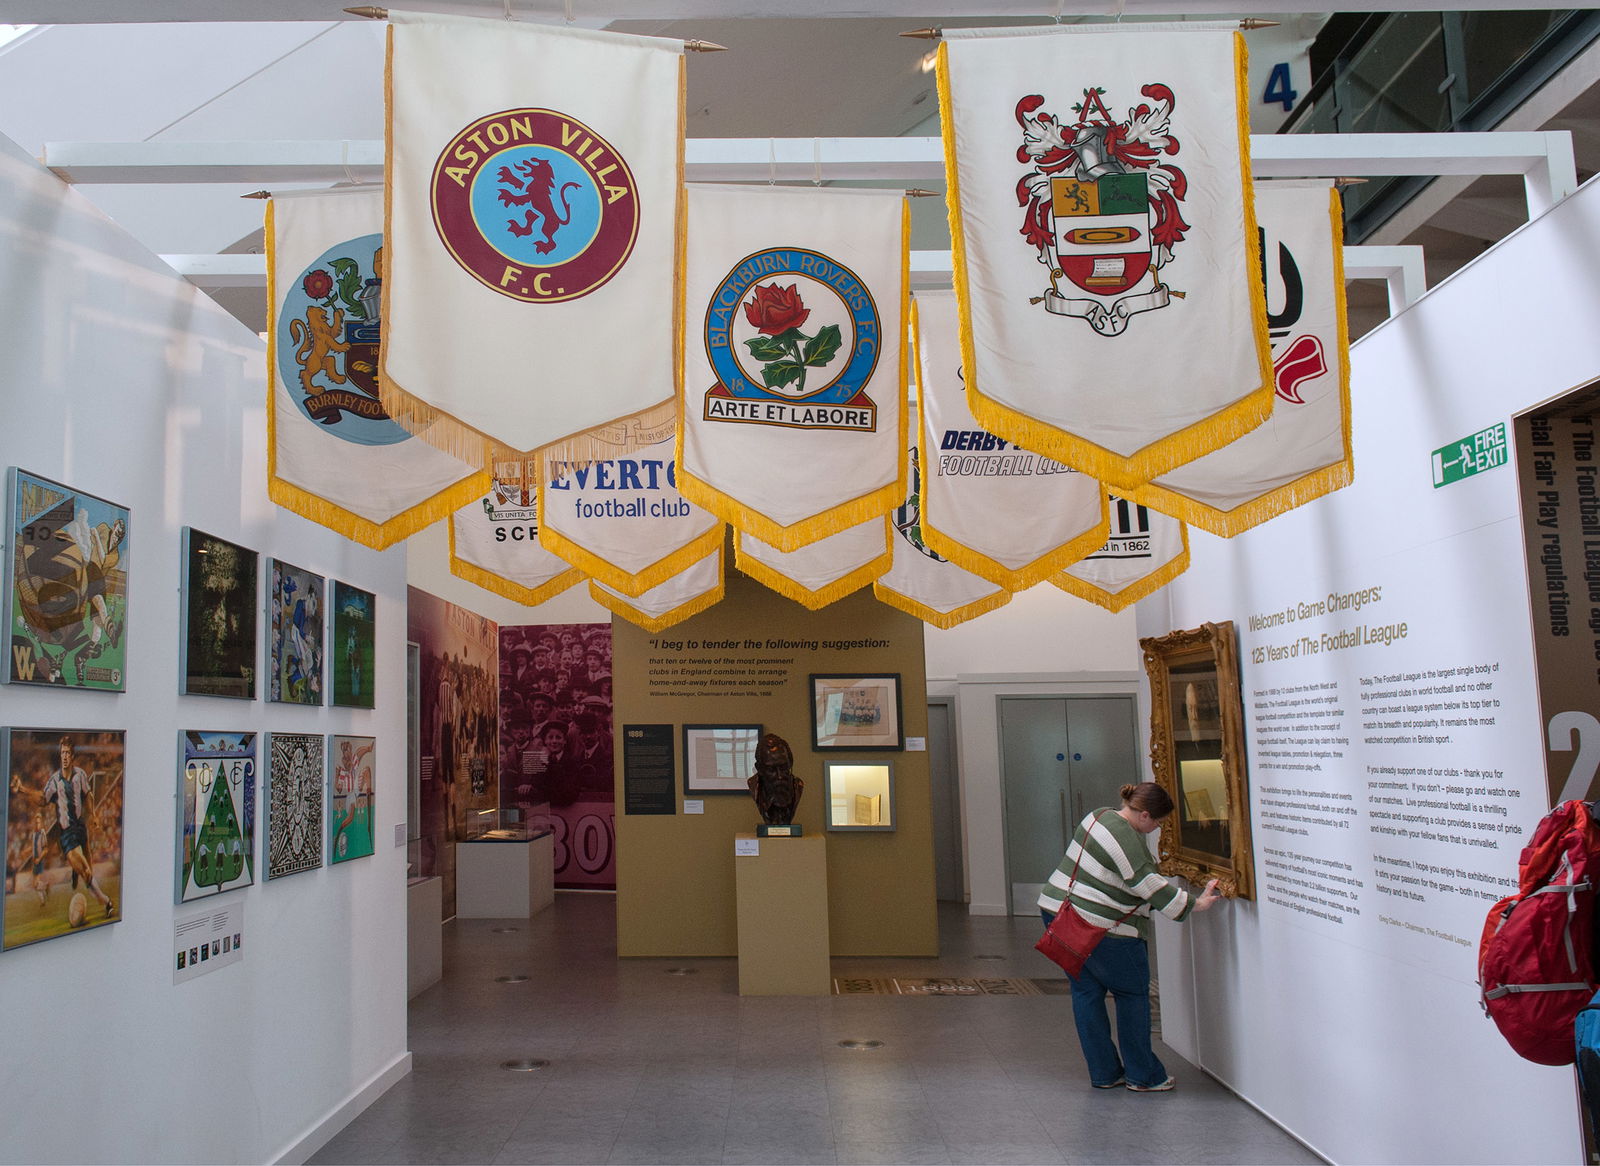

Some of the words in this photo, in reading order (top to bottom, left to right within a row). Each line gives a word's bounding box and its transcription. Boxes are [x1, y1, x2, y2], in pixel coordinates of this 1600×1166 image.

[1264, 63, 1297, 110] 4
[444, 117, 533, 187] ASTON
[560, 123, 628, 205] VILLA
[500, 266, 564, 296] F.C.
[711, 254, 790, 349] BLACKBURN
[800, 255, 868, 311] ROVERS
[731, 378, 745, 392] 18
[834, 384, 852, 398] 75
[307, 393, 357, 412] BURNLEY
[710, 400, 760, 418] ARTE
[766, 404, 786, 420] ET
[791, 408, 869, 426] LABORE
[1474, 423, 1505, 454] FIRE
[1572, 430, 1594, 461] The
[938, 456, 1033, 476] FOOTBALL
[1476, 444, 1507, 472] EXIT
[1534, 451, 1556, 486] Fair
[576, 498, 646, 518] football
[651, 498, 690, 517] club
[1537, 491, 1560, 528] Play
[1576, 466, 1600, 536] Football
[1122, 541, 1150, 551] 1862
[1541, 534, 1570, 637] regulations
[1249, 610, 1284, 632] Welcome
[1286, 606, 1296, 624] to
[1297, 599, 1326, 622] Game
[1327, 586, 1382, 612] Changers:
[661, 639, 683, 651] beg
[687, 640, 698, 648] to
[702, 639, 741, 648] tender
[744, 639, 762, 648] the
[766, 639, 818, 650] following
[821, 639, 890, 650] suggestion:
[1250, 646, 1265, 665] 125
[1266, 641, 1289, 662] Years
[1290, 638, 1300, 658] of
[1301, 636, 1318, 656] The
[1320, 628, 1361, 652] Football
[1364, 621, 1408, 646] League
[1373, 675, 1382, 683] The
[1382, 673, 1402, 683] Football
[1402, 672, 1421, 682] League
[1427, 670, 1436, 678] the
[1436, 667, 1456, 679] largest
[1456, 665, 1474, 676] single
[1474, 664, 1491, 674] body
[1492, 662, 1499, 672] of
[1418, 686, 1432, 695] world
[1433, 684, 1454, 694] football
[1454, 683, 1466, 692] and
[1475, 681, 1492, 691] other
[1443, 701, 1459, 710] below
[1469, 700, 1480, 710] top
[1481, 699, 1492, 708] tier
[1492, 698, 1500, 707] to
[1445, 718, 1468, 726] remains
[1468, 717, 1478, 726] the
[1479, 716, 1495, 725] most
[1396, 767, 1416, 776] support
[1427, 767, 1433, 775] of
[1443, 767, 1459, 776] clubs
[1463, 768, 1480, 777] thank
[1480, 770, 1493, 780] you
[1493, 768, 1503, 778] for
[1416, 784, 1426, 792] you
[1445, 784, 1464, 794] please
[1465, 787, 1473, 796] go
[1474, 786, 1486, 795] and
[1486, 787, 1506, 796] watch
[1507, 789, 1520, 798] one
[1405, 797, 1416, 806] Live
[1417, 799, 1449, 809] professional
[1449, 801, 1471, 811] football
[1483, 804, 1507, 817] thrilling
[1434, 816, 1446, 826] club
[1446, 819, 1471, 828] provides
[1477, 822, 1496, 831] sense
[1496, 822, 1503, 832] of
[1504, 824, 1522, 834] pride
[1436, 832, 1449, 842] fans
[1449, 834, 1460, 844] that
[1415, 861, 1429, 872] hope
[1429, 865, 1439, 874] you
[1439, 867, 1455, 878] enjoy
[1455, 868, 1466, 878] this
[1467, 871, 1496, 884] exhibition
[1497, 877, 1510, 887] and
